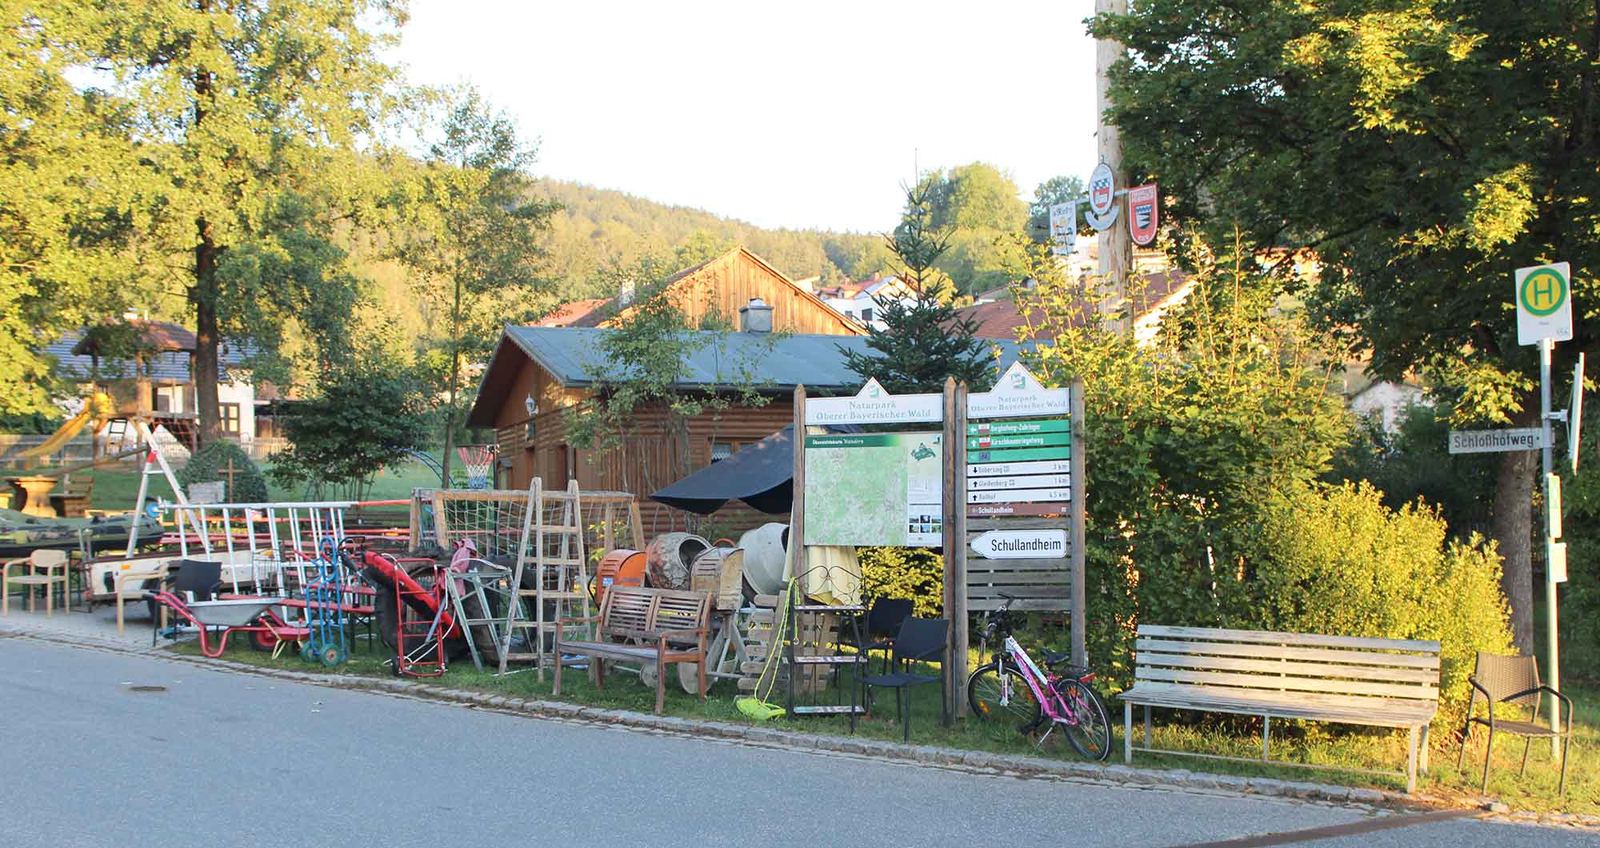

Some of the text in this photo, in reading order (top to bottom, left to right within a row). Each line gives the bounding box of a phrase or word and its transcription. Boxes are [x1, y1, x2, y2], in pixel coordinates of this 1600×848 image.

[998, 395, 1038, 403] Naturpark
[849, 401, 897, 410] Naturpark
[816, 410, 931, 421] Oberer Bayerischer Wald
[1453, 434, 1534, 449] Schloßhofweg
[1058, 490, 1068, 498] km
[978, 506, 1014, 514] Schullandheim
[991, 537, 1062, 552] Schullandheim
